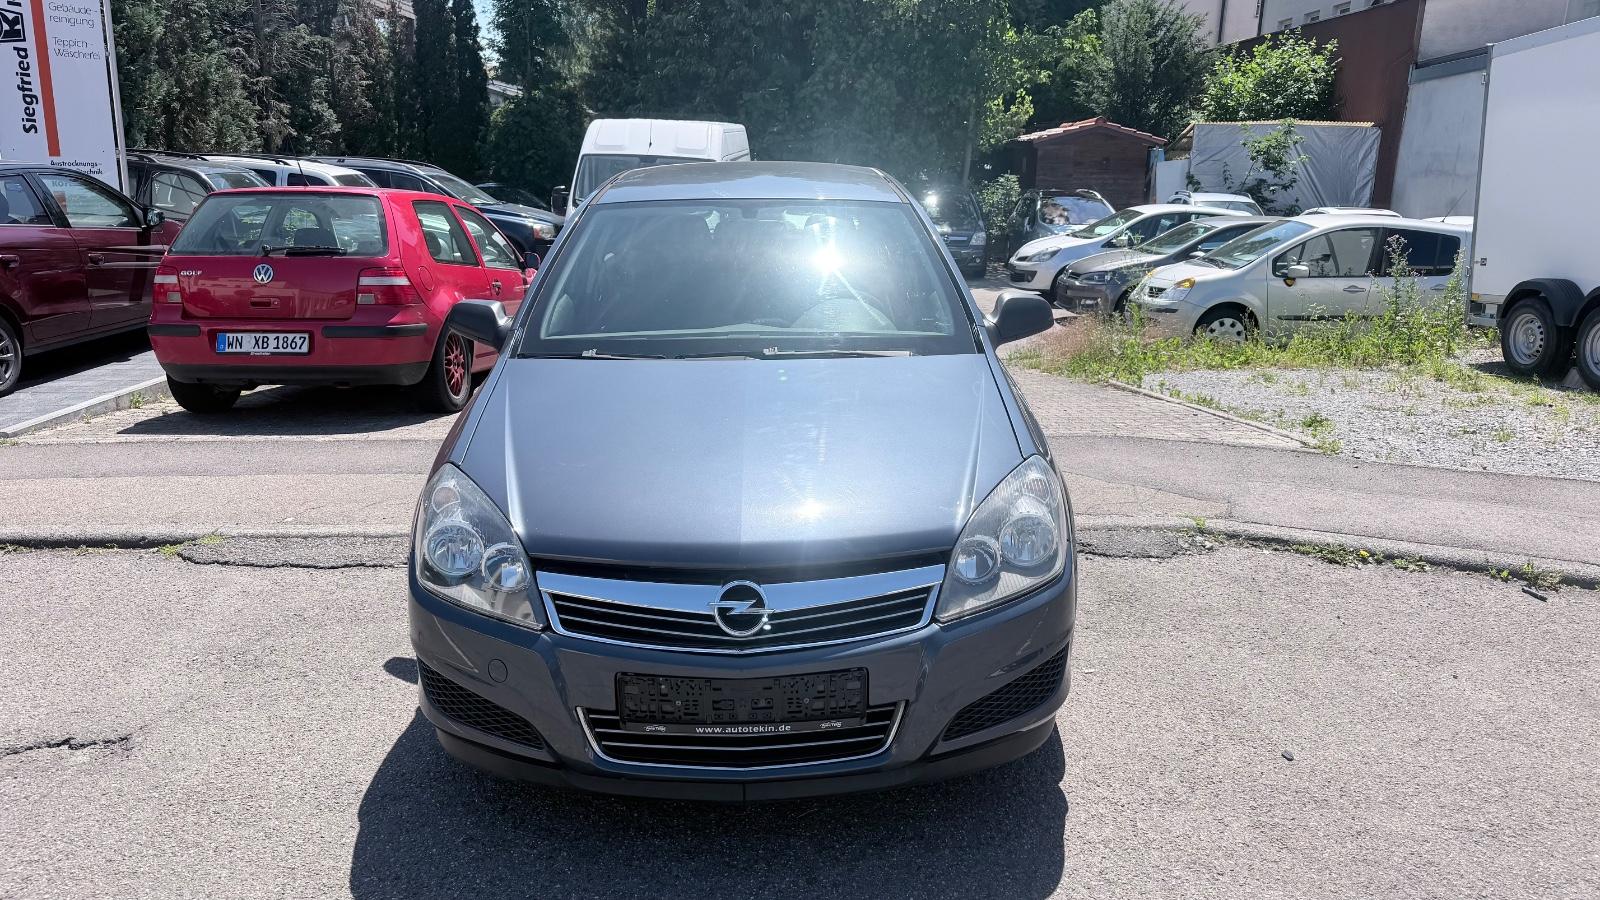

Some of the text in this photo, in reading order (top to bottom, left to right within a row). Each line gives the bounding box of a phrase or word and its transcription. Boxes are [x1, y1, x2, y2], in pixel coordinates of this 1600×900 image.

[50, 15, 95, 28] reinigung
[53, 48, 101, 60] Wäscherei
[12, 46, 39, 134] Siegfried
[227, 335, 307, 350] WN XB 1867
[695, 724, 791, 734] www.autotekin.de
